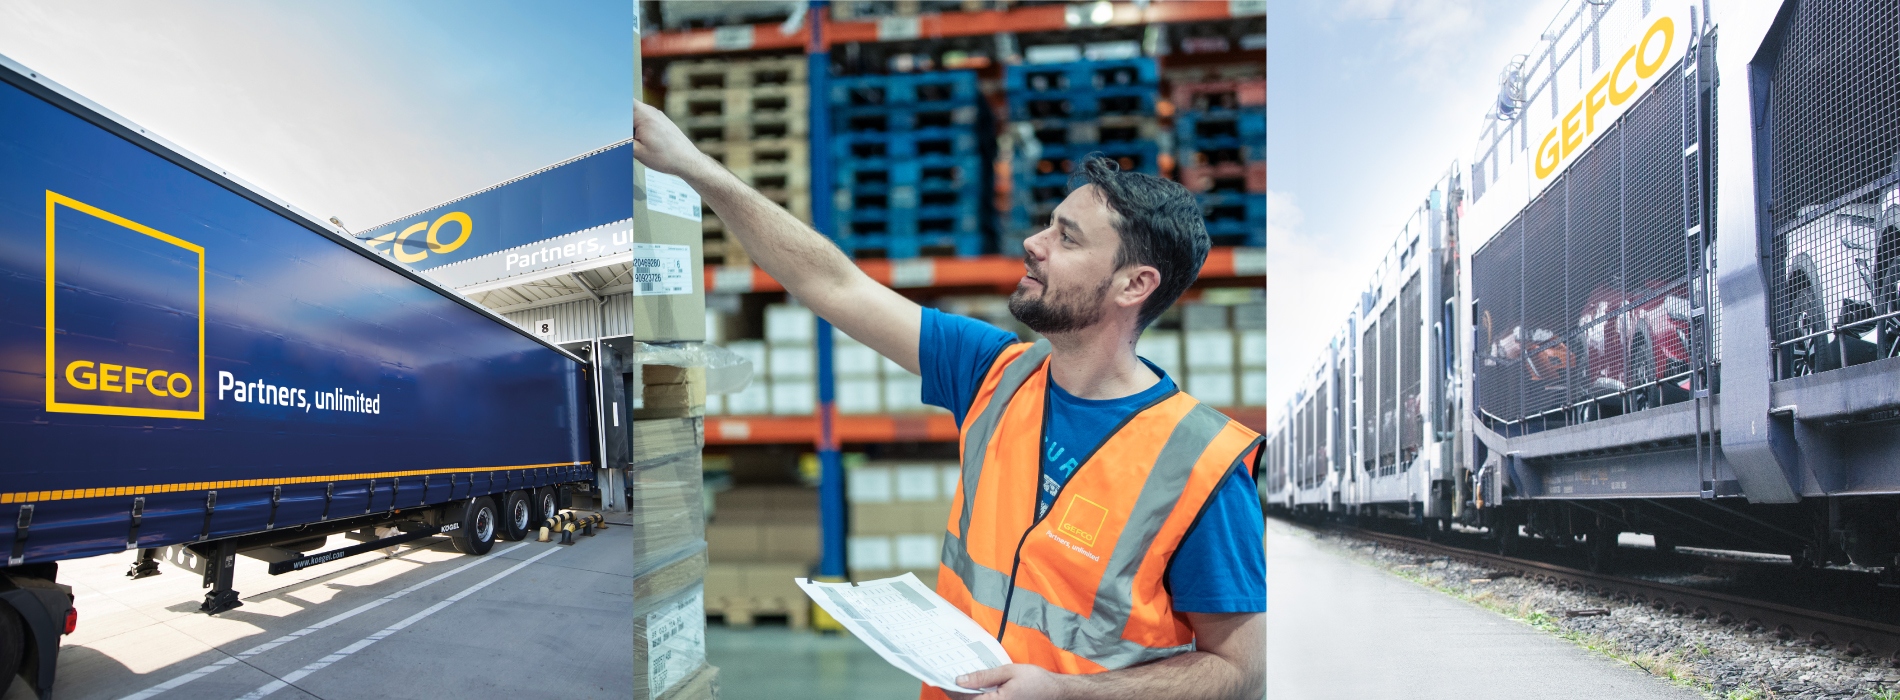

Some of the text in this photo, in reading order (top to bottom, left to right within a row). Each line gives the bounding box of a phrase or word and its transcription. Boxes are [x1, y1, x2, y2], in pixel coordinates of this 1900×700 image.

[1534, 16, 1675, 180] GEFCO
[505, 228, 633, 270] Partners, u
[541, 323, 549, 334] 8
[65, 360, 193, 398] GEFCO
[218, 370, 380, 415] Partners, unlimited
[1044, 435, 1079, 478] UR
[1045, 530, 1100, 562] Partners, unlimited
[1063, 523, 1093, 541] GEFCO
[293, 551, 345, 569] www.koegel.com
